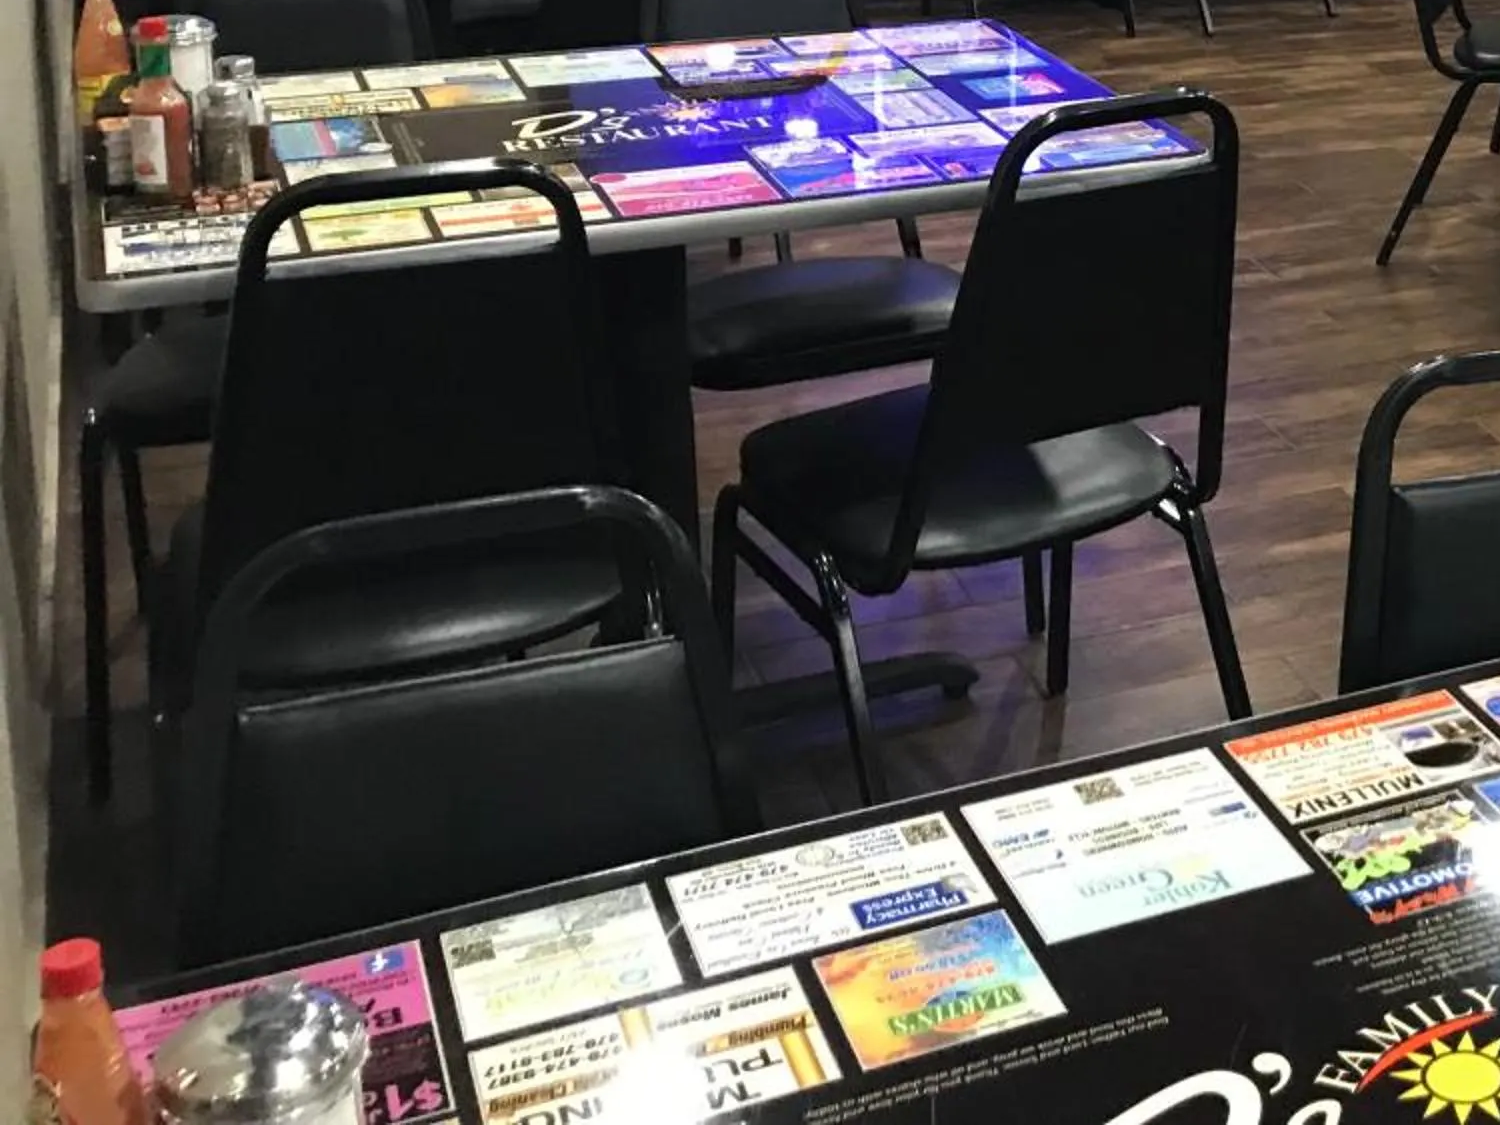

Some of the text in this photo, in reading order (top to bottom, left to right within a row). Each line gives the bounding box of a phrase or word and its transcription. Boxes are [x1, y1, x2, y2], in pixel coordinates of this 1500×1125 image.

[501, 115, 774, 153] RESTAURANT
[1284, 771, 1427, 820] MULLENIX
[858, 884, 939, 914] Express
[1076, 865, 1178, 907] Green
[862, 890, 962, 925] Pharmacy
[725, 988, 791, 1013] James
[1314, 984, 1500, 1093] FAMILY
